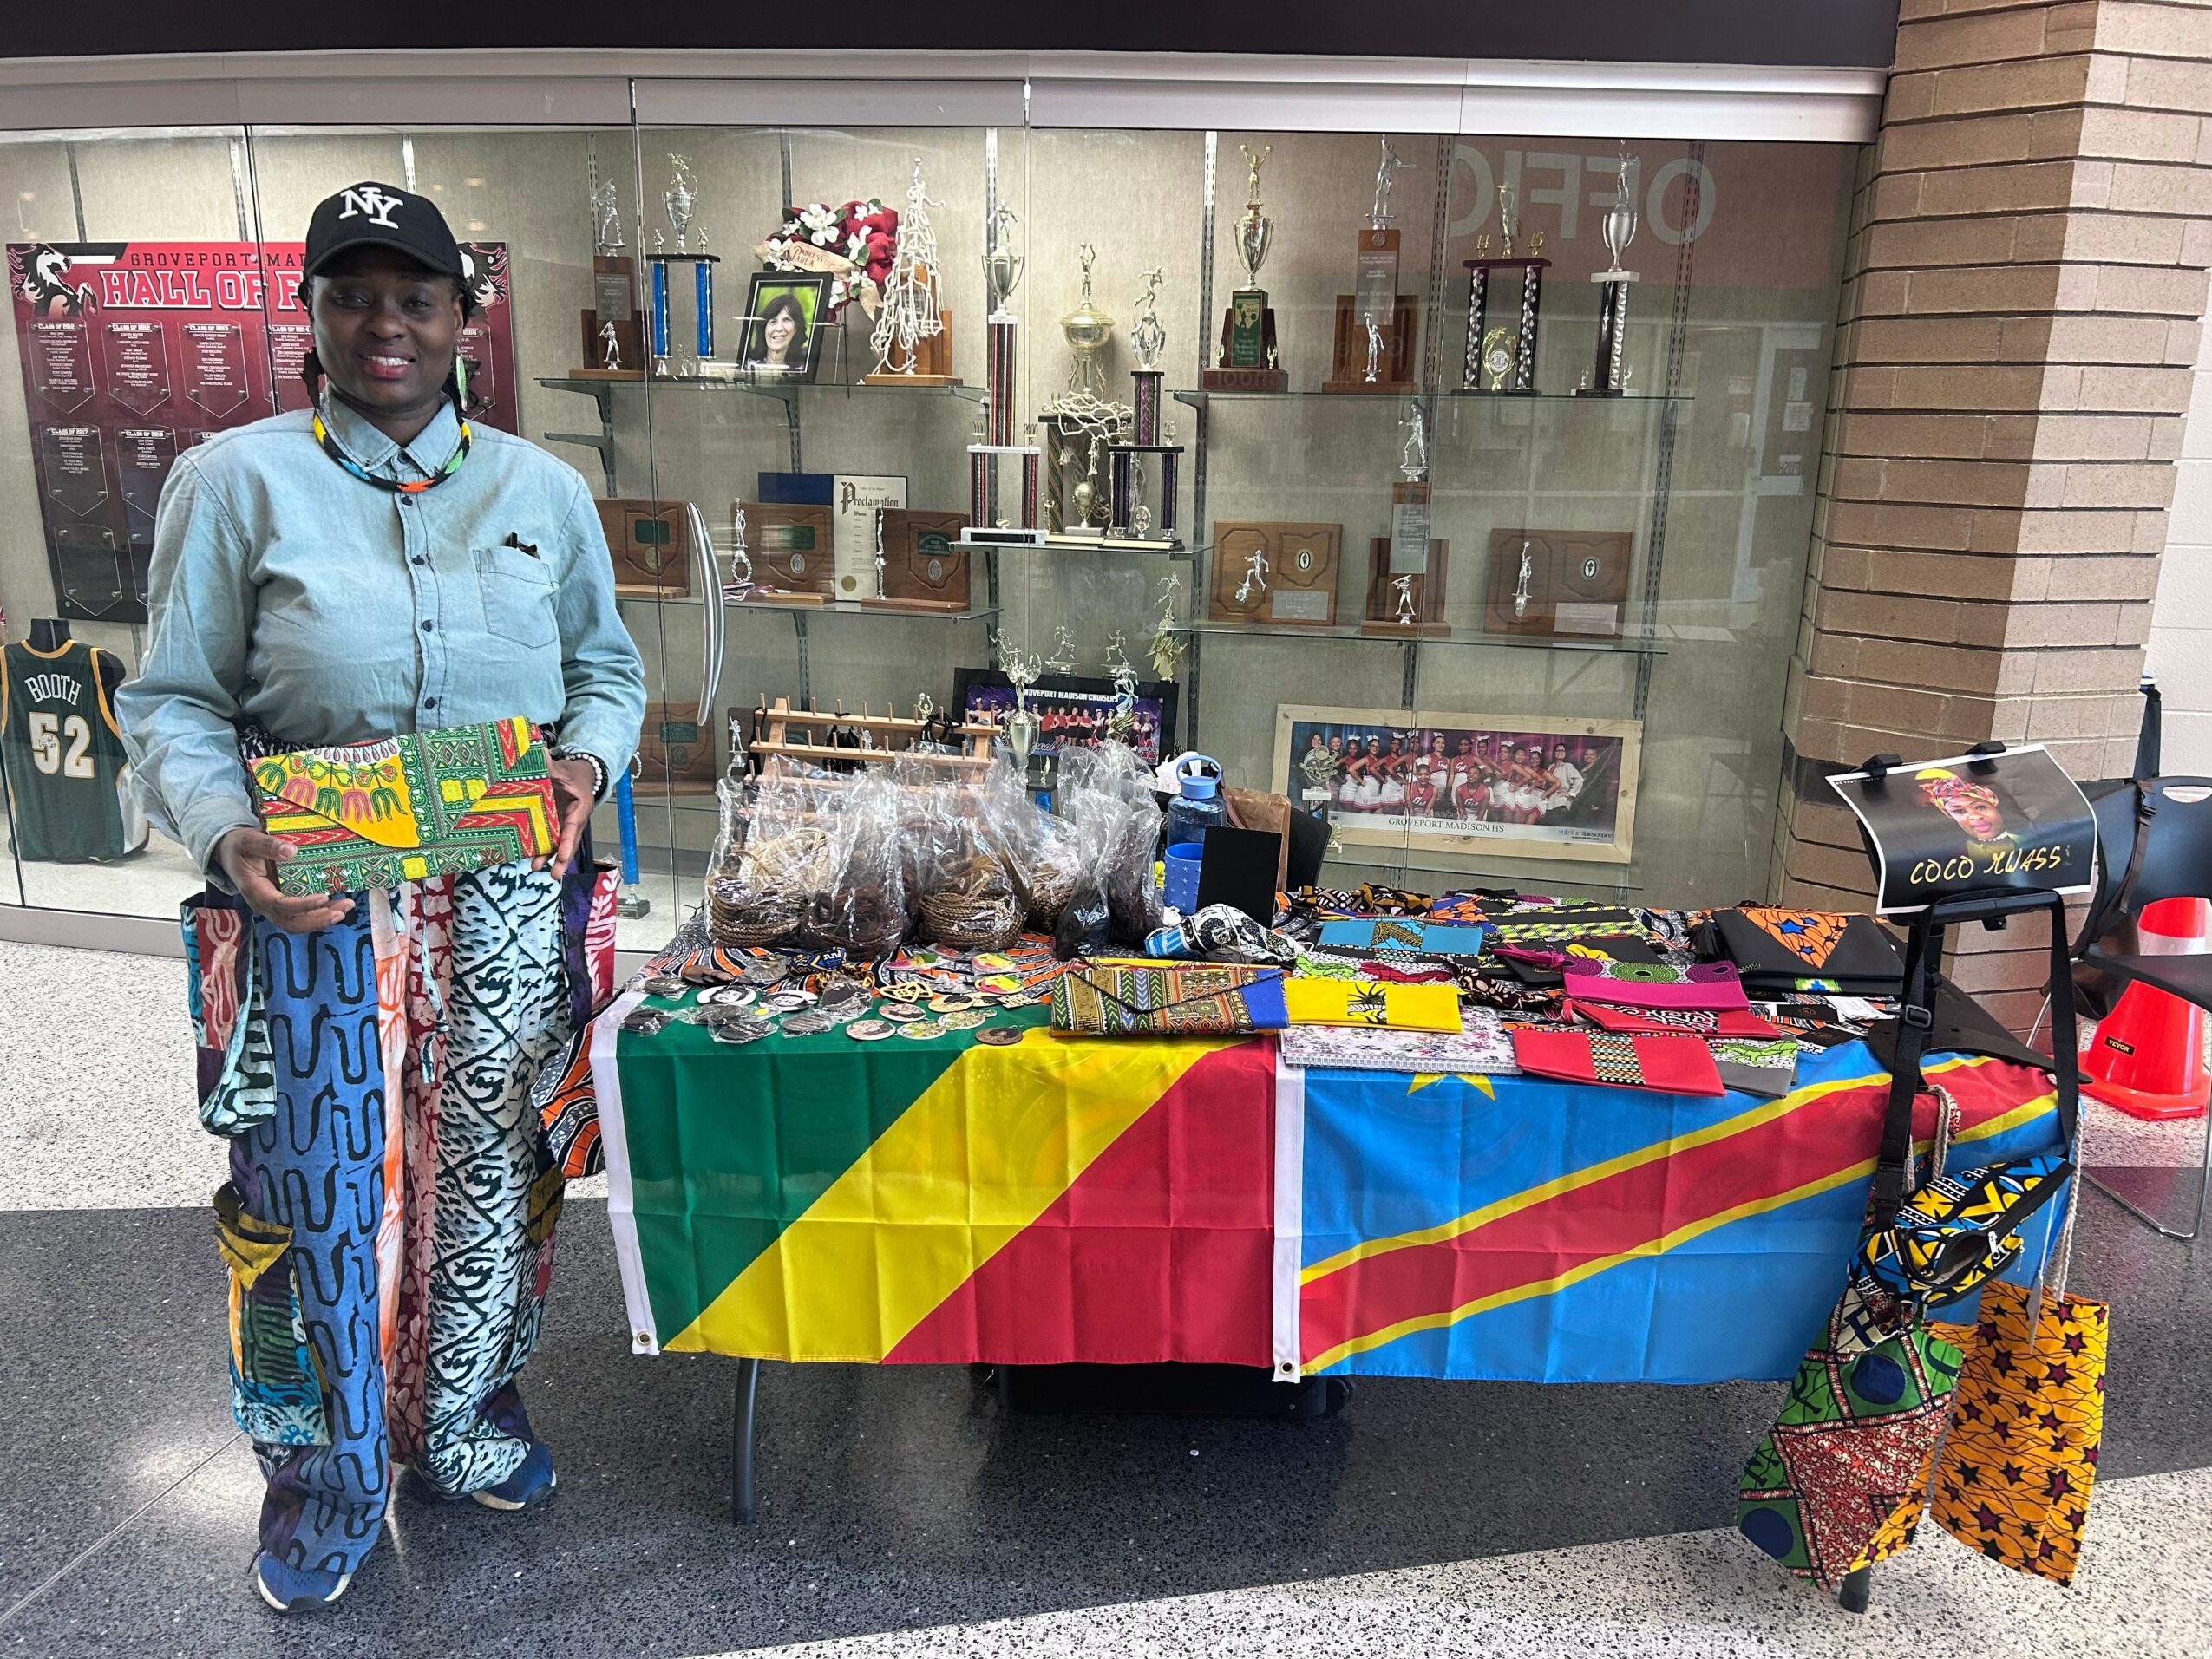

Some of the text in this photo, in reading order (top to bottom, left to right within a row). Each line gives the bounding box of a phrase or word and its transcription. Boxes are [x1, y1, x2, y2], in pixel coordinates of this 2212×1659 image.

[339, 186, 404, 230] NY
[131, 253, 252, 266] GROVEPORT
[98, 270, 213, 310] HALL
[216, 271, 269, 312] OF
[840, 481, 900, 515] Proclamation
[24, 673, 82, 706] BOOTH
[1057, 691, 1088, 701] MADISON
[1088, 693, 1119, 702] CRUISERS
[28, 711, 95, 779] 52
[1388, 818, 1443, 829] GROVEPORT
[1445, 821, 1489, 833] MADISON
[1910, 855, 1974, 885] COCO
[2109, 1039, 2130, 1053] VEVOR
